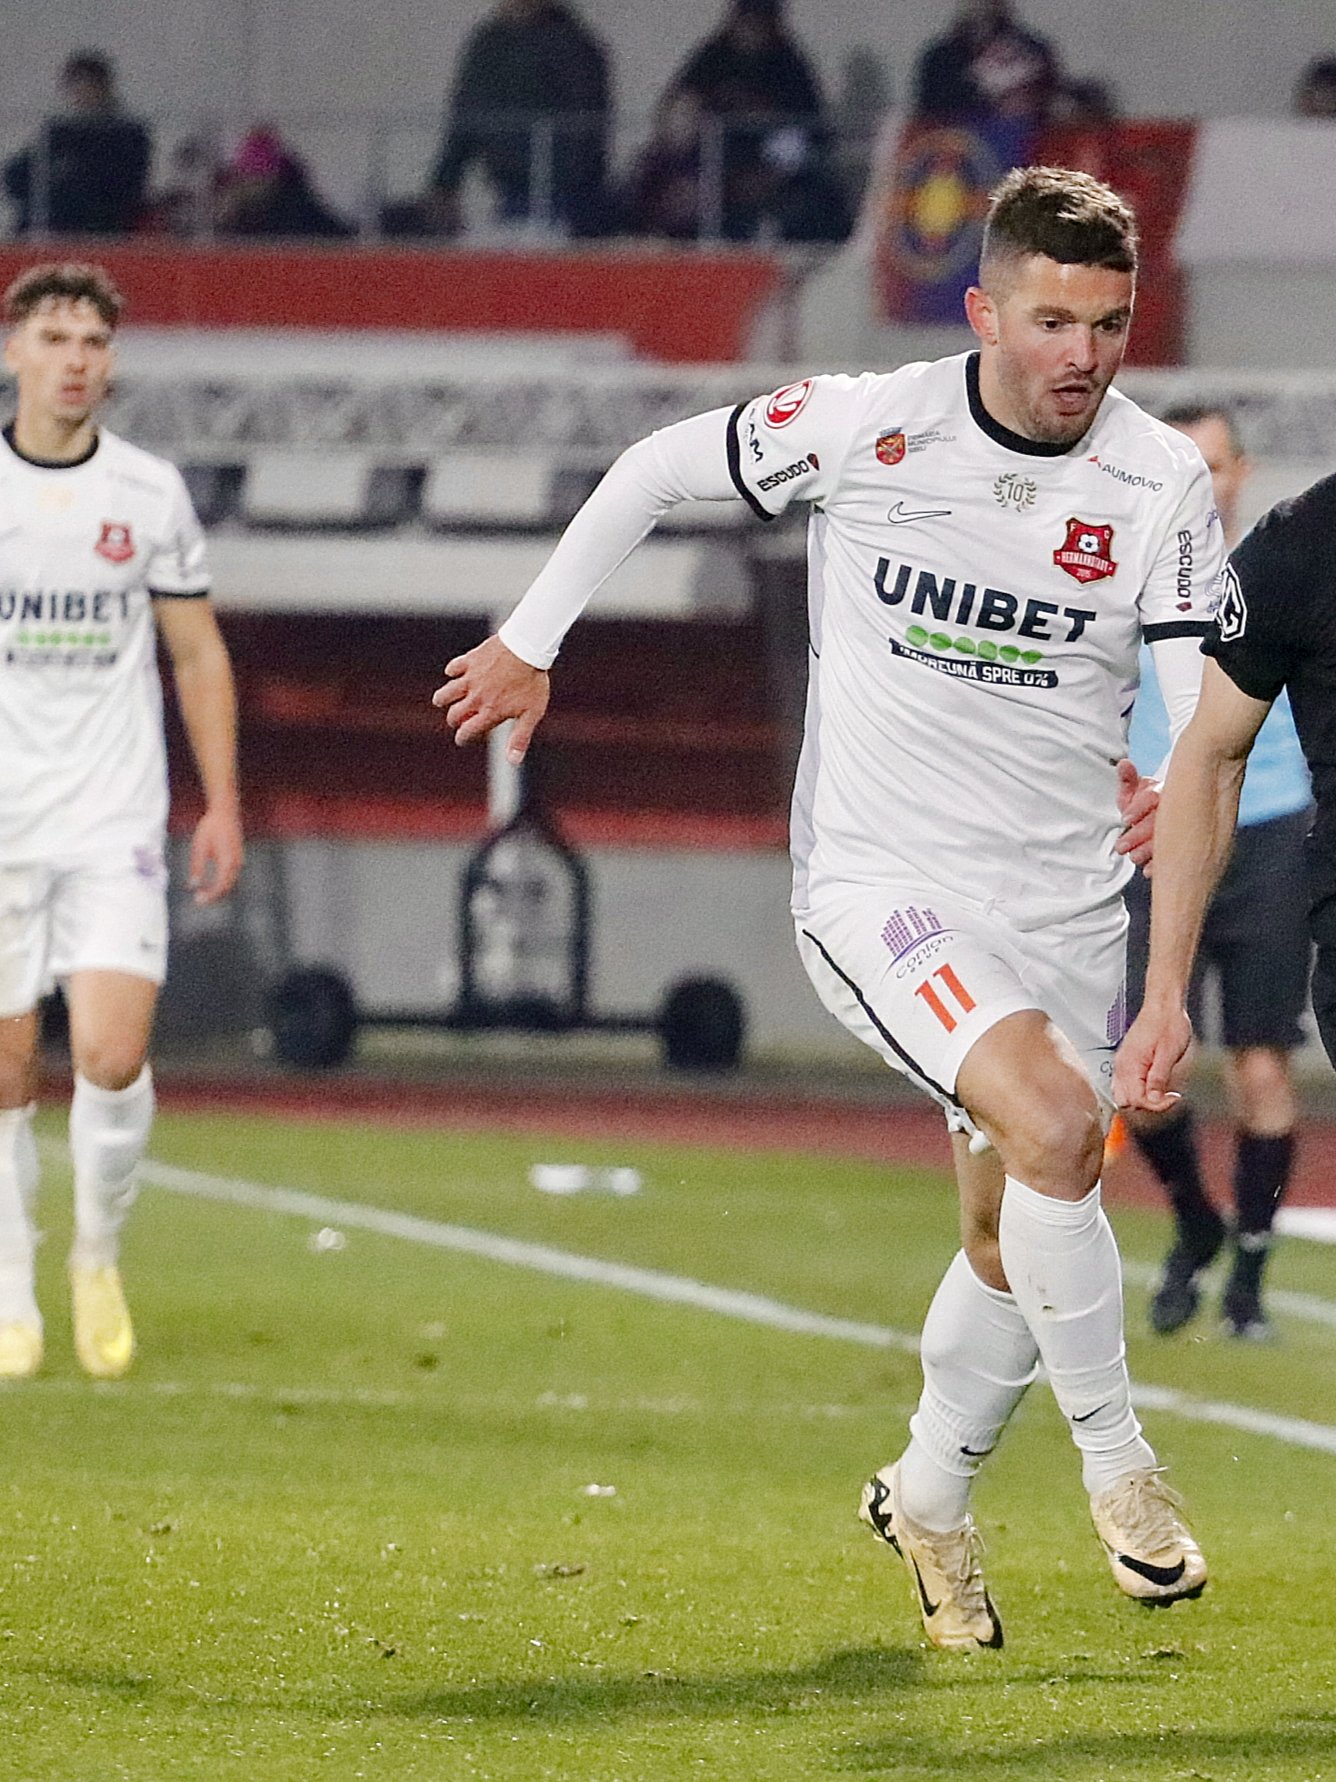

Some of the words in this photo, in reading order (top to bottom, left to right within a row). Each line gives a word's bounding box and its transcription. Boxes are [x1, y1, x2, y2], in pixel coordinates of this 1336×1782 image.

[757, 460, 810, 492] ESCUDO
[1102, 464, 1163, 493] AUMOVIO
[1007, 482, 1025, 503] 10
[1177, 530, 1193, 599] ESCUDO
[874, 556, 1097, 643] UNIBET
[982, 666, 1021, 684] SPRE
[914, 963, 977, 1034] 11
